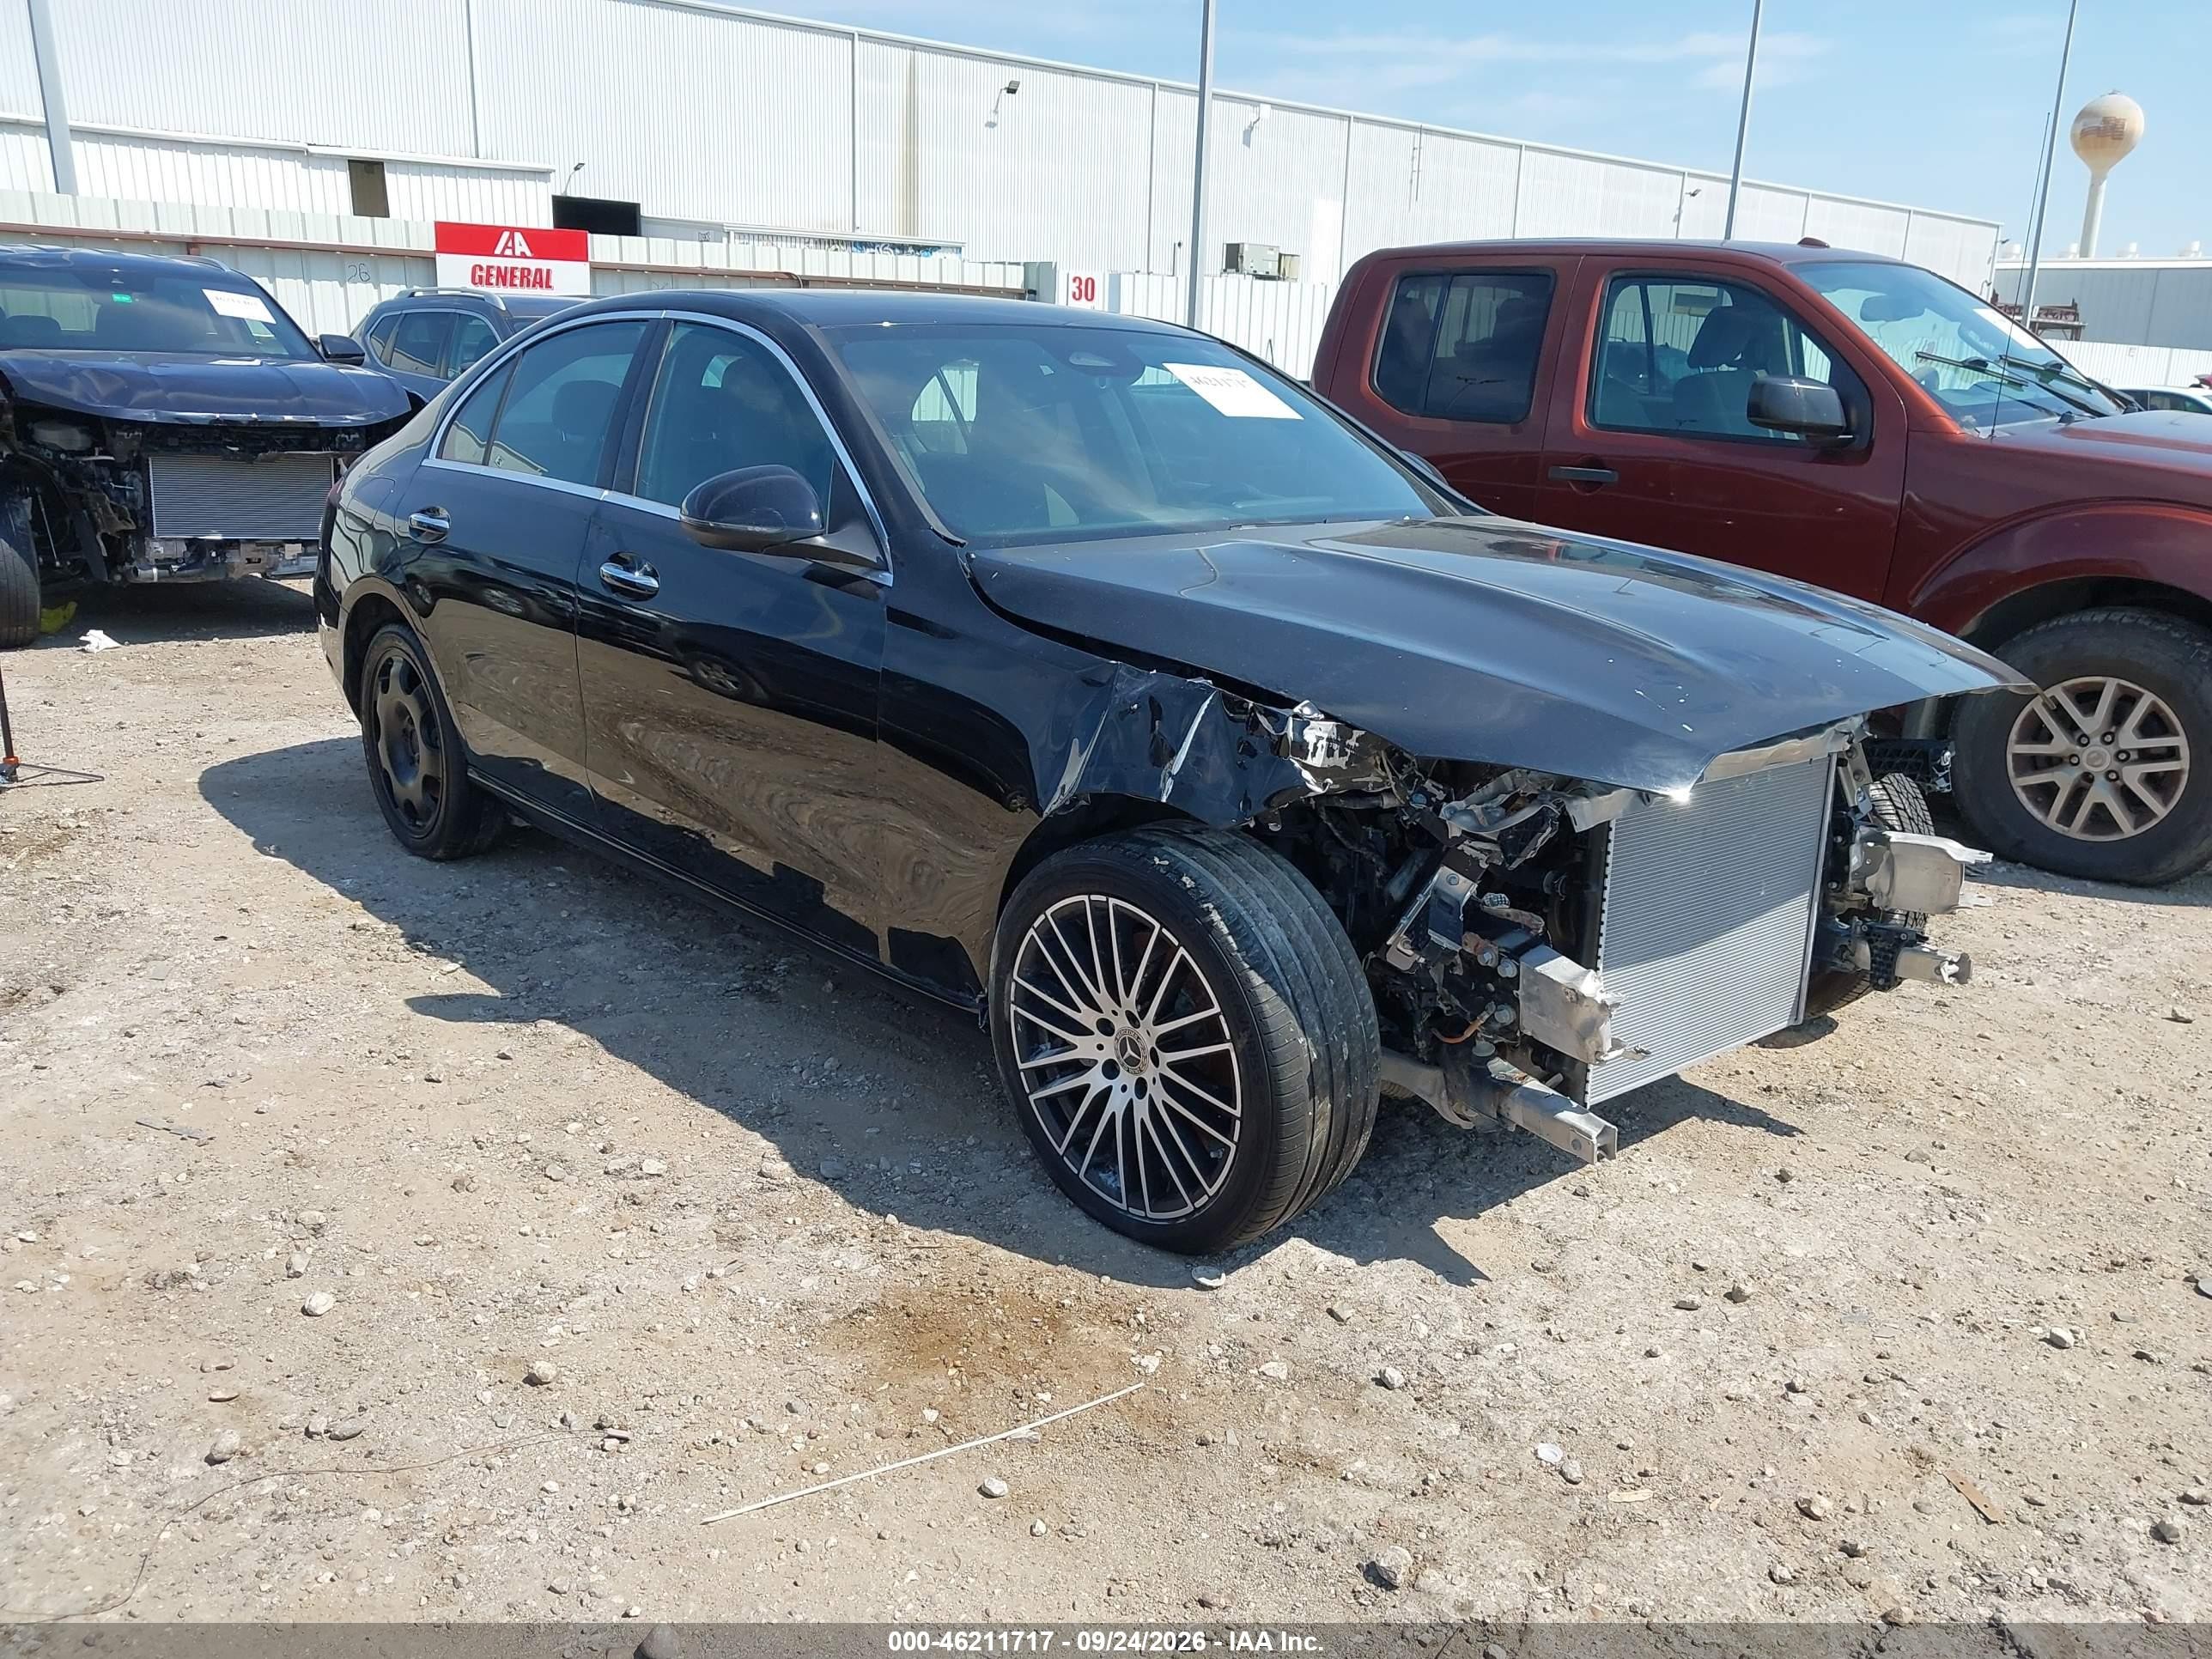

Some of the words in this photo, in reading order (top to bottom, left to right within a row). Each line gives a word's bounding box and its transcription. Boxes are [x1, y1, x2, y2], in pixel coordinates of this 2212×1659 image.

[347, 263, 371, 282] 26
[471, 264, 554, 290] GENERAL
[1072, 276, 1096, 301] 30
